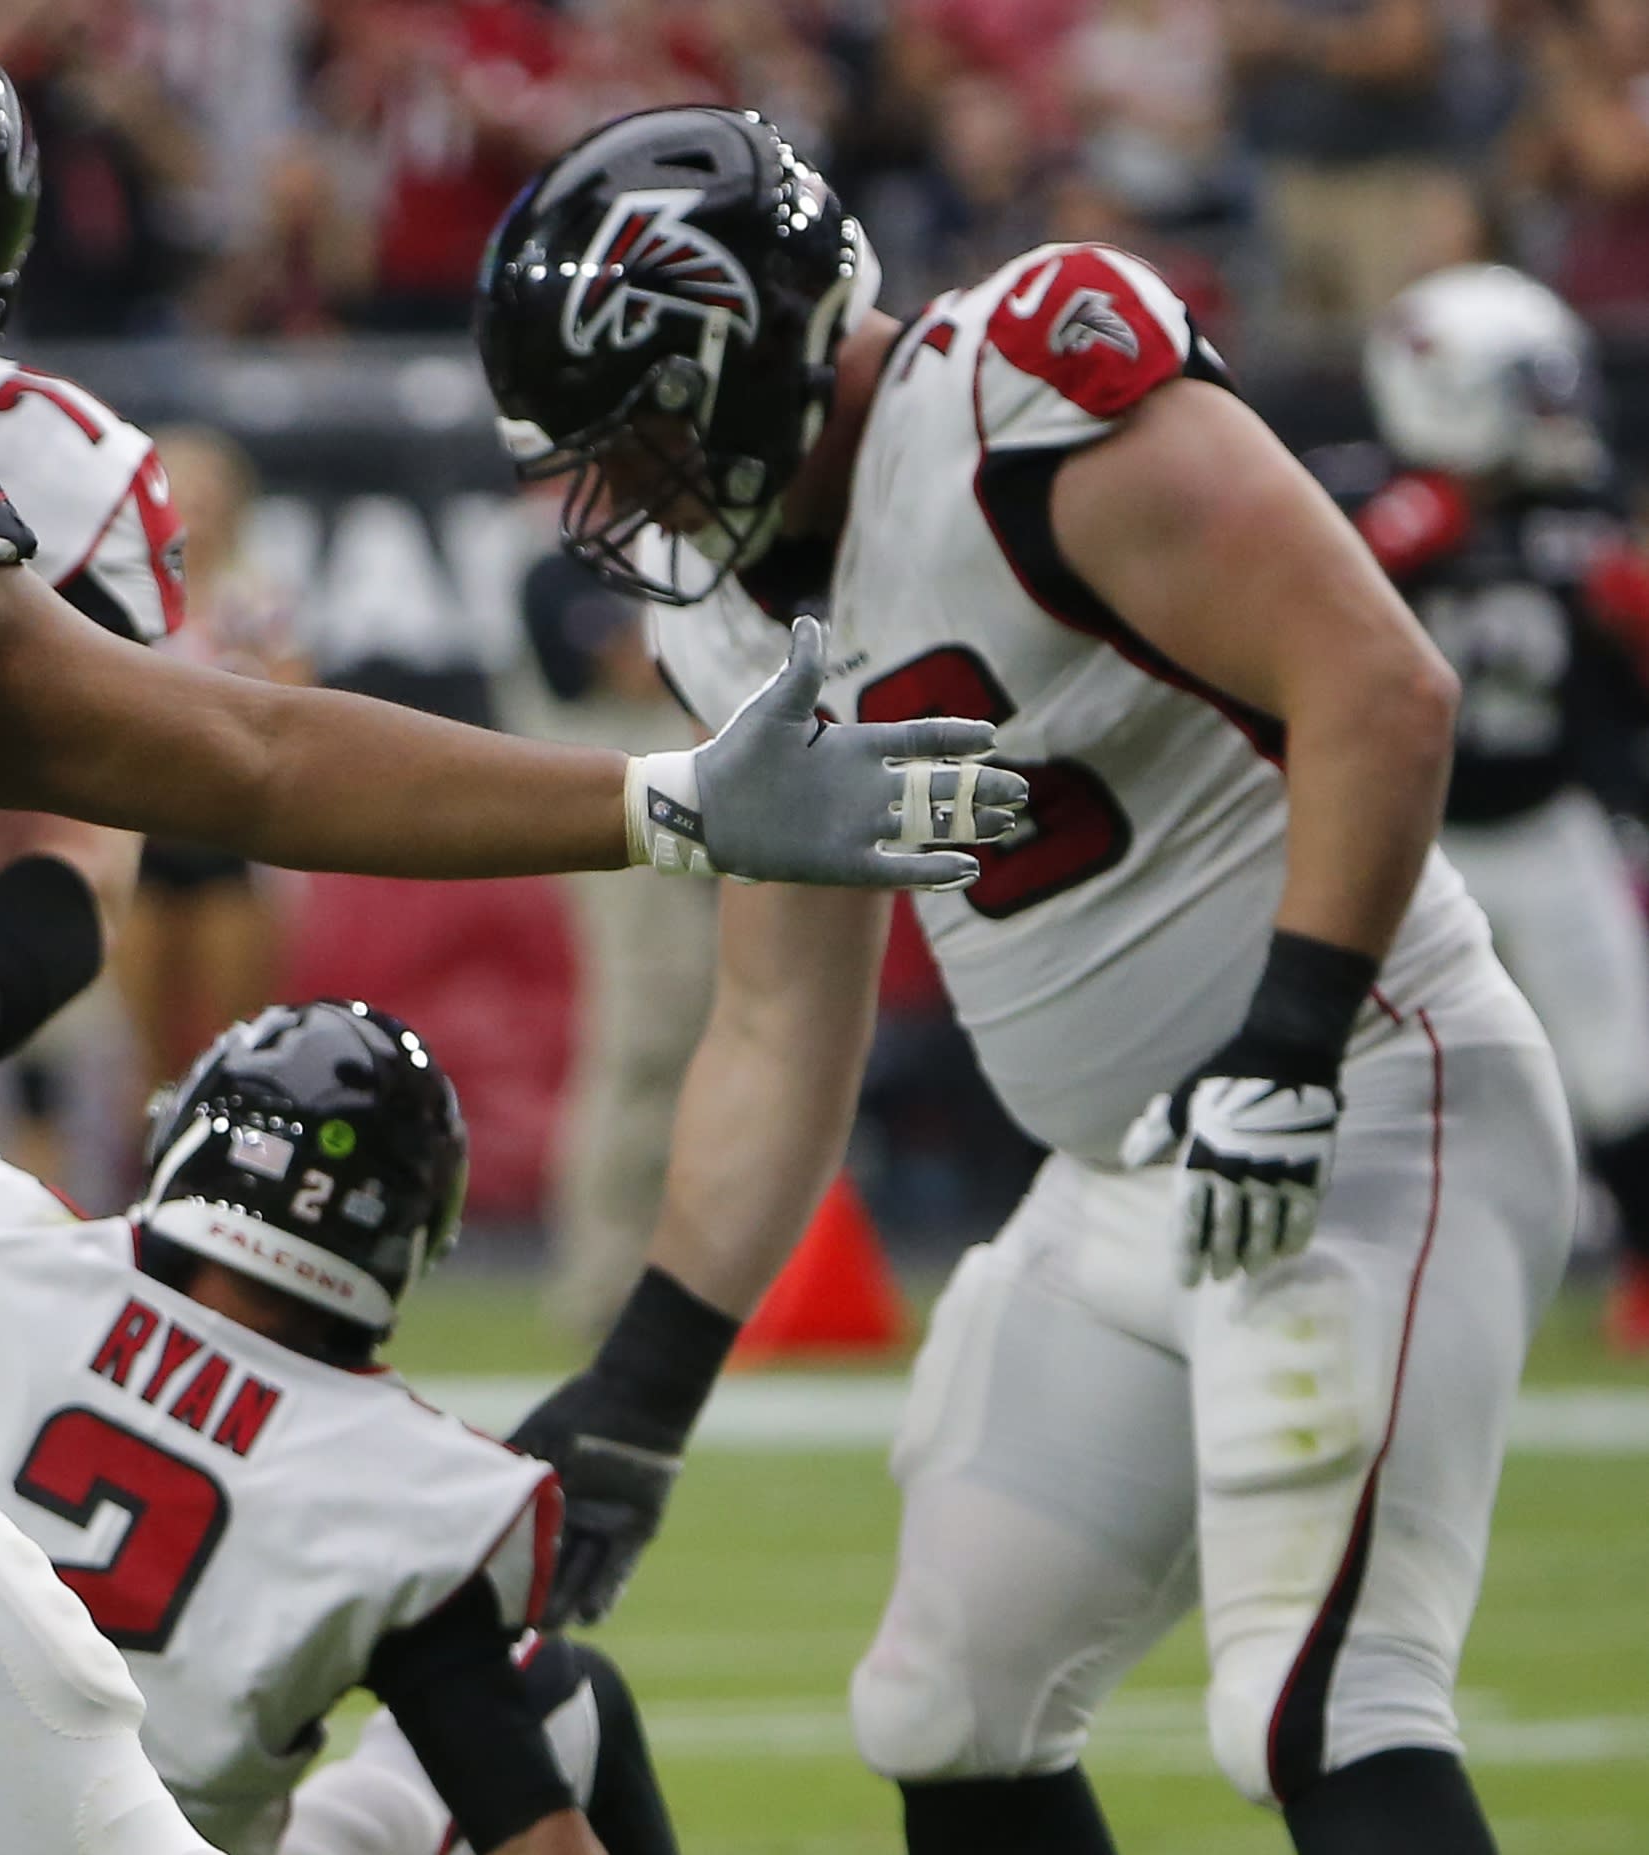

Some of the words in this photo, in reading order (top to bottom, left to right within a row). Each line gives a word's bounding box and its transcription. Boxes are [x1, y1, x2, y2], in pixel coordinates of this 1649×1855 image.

[290, 1167, 335, 1225] 2
[209, 1221, 356, 1299] FALCONS
[88, 1300, 284, 1458] RYAN
[13, 1404, 232, 1655] 2
